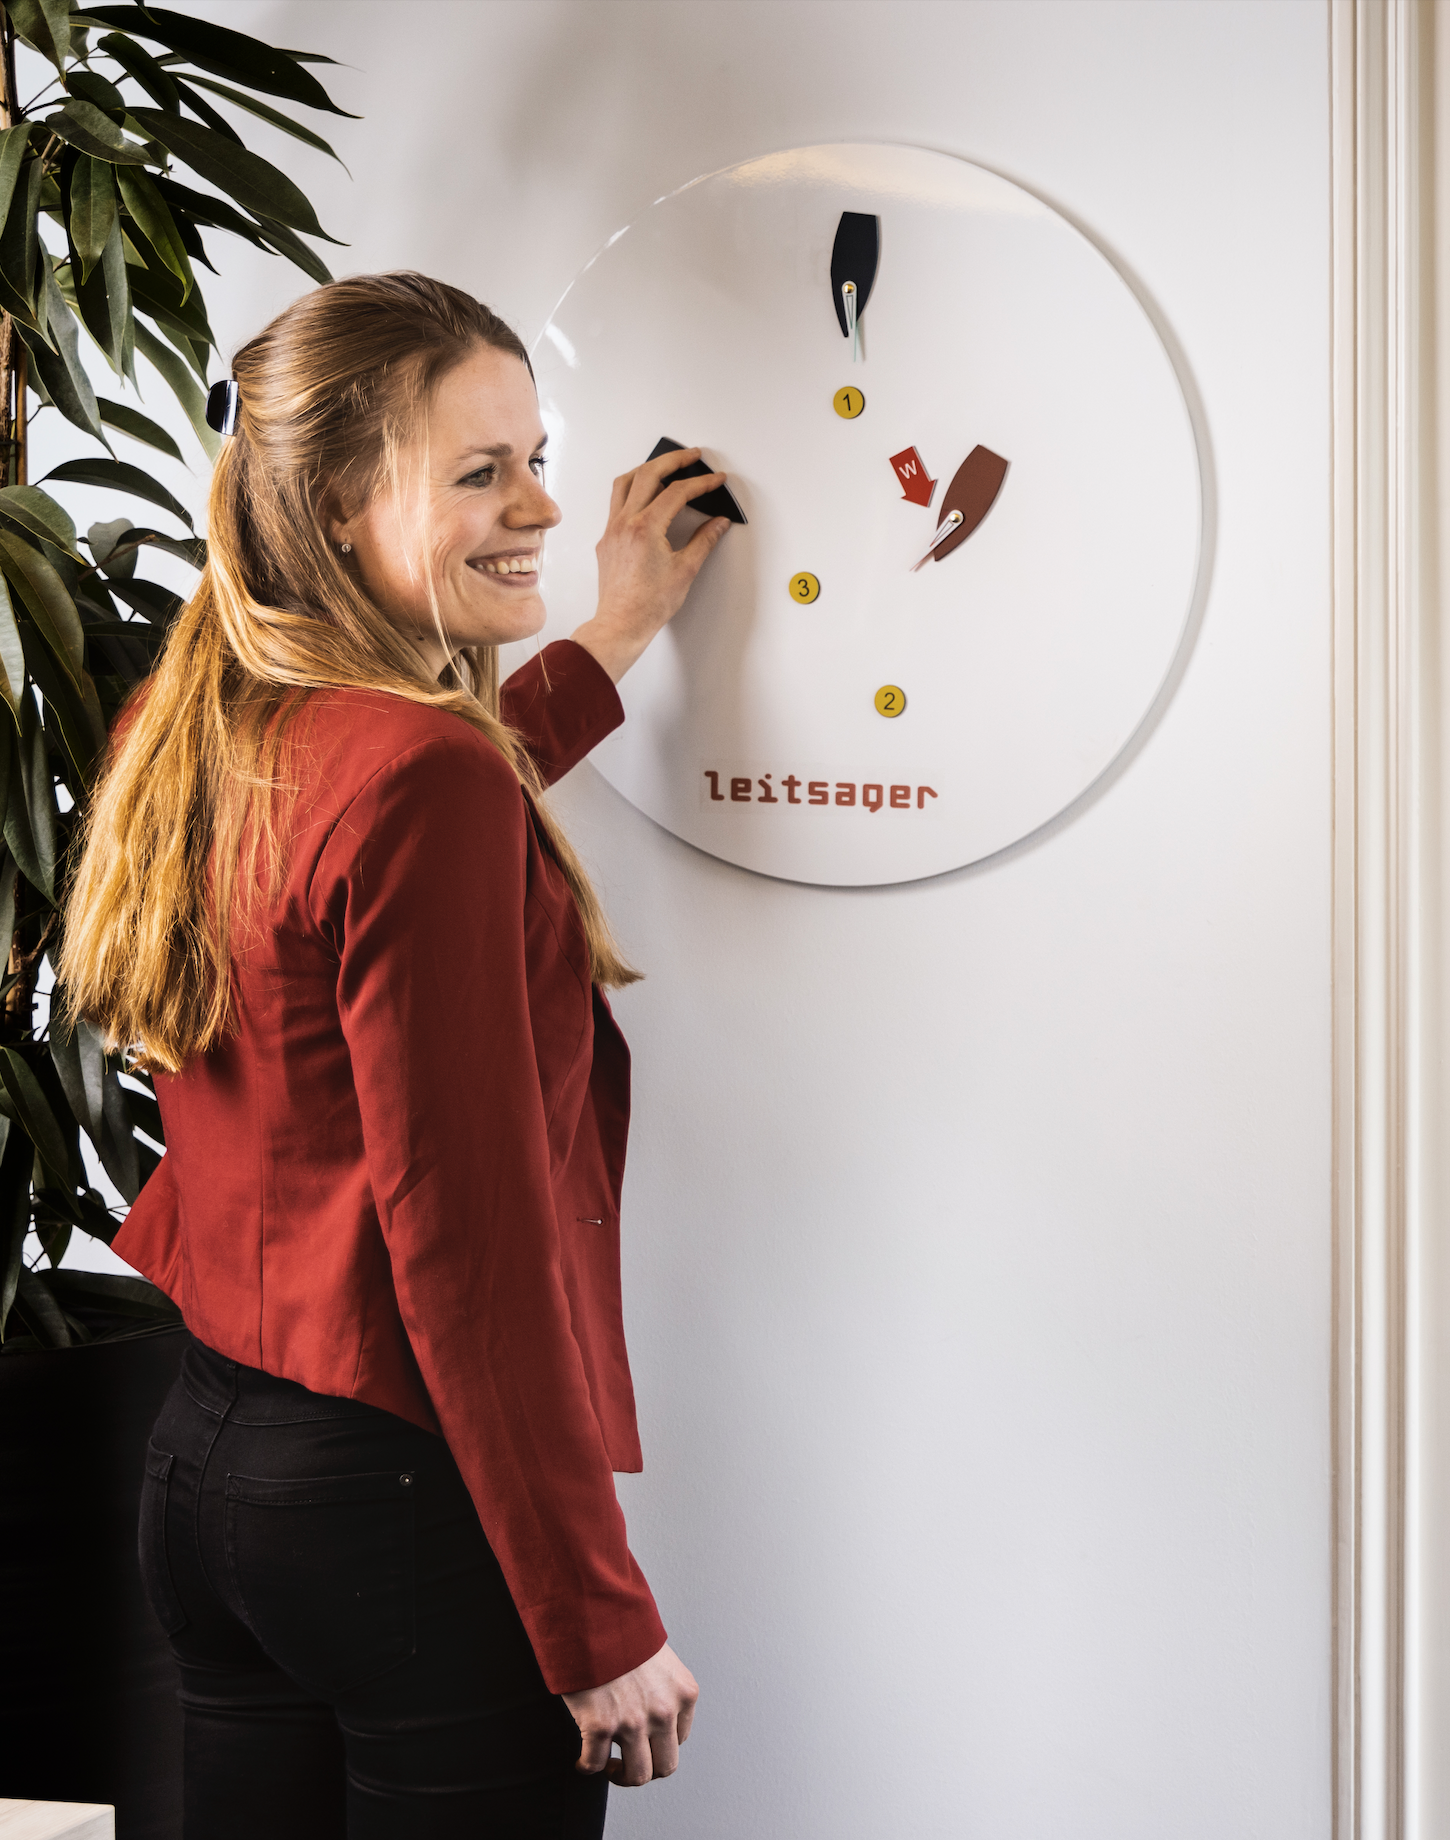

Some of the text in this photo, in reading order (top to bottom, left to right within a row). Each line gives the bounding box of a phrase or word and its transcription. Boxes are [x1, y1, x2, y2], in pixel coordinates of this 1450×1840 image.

[842, 393, 851, 412] 1
[898, 459, 918, 480] W
[797, 578, 810, 598] 3
[883, 691, 896, 711] 2
[703, 770, 939, 814] leitsager
